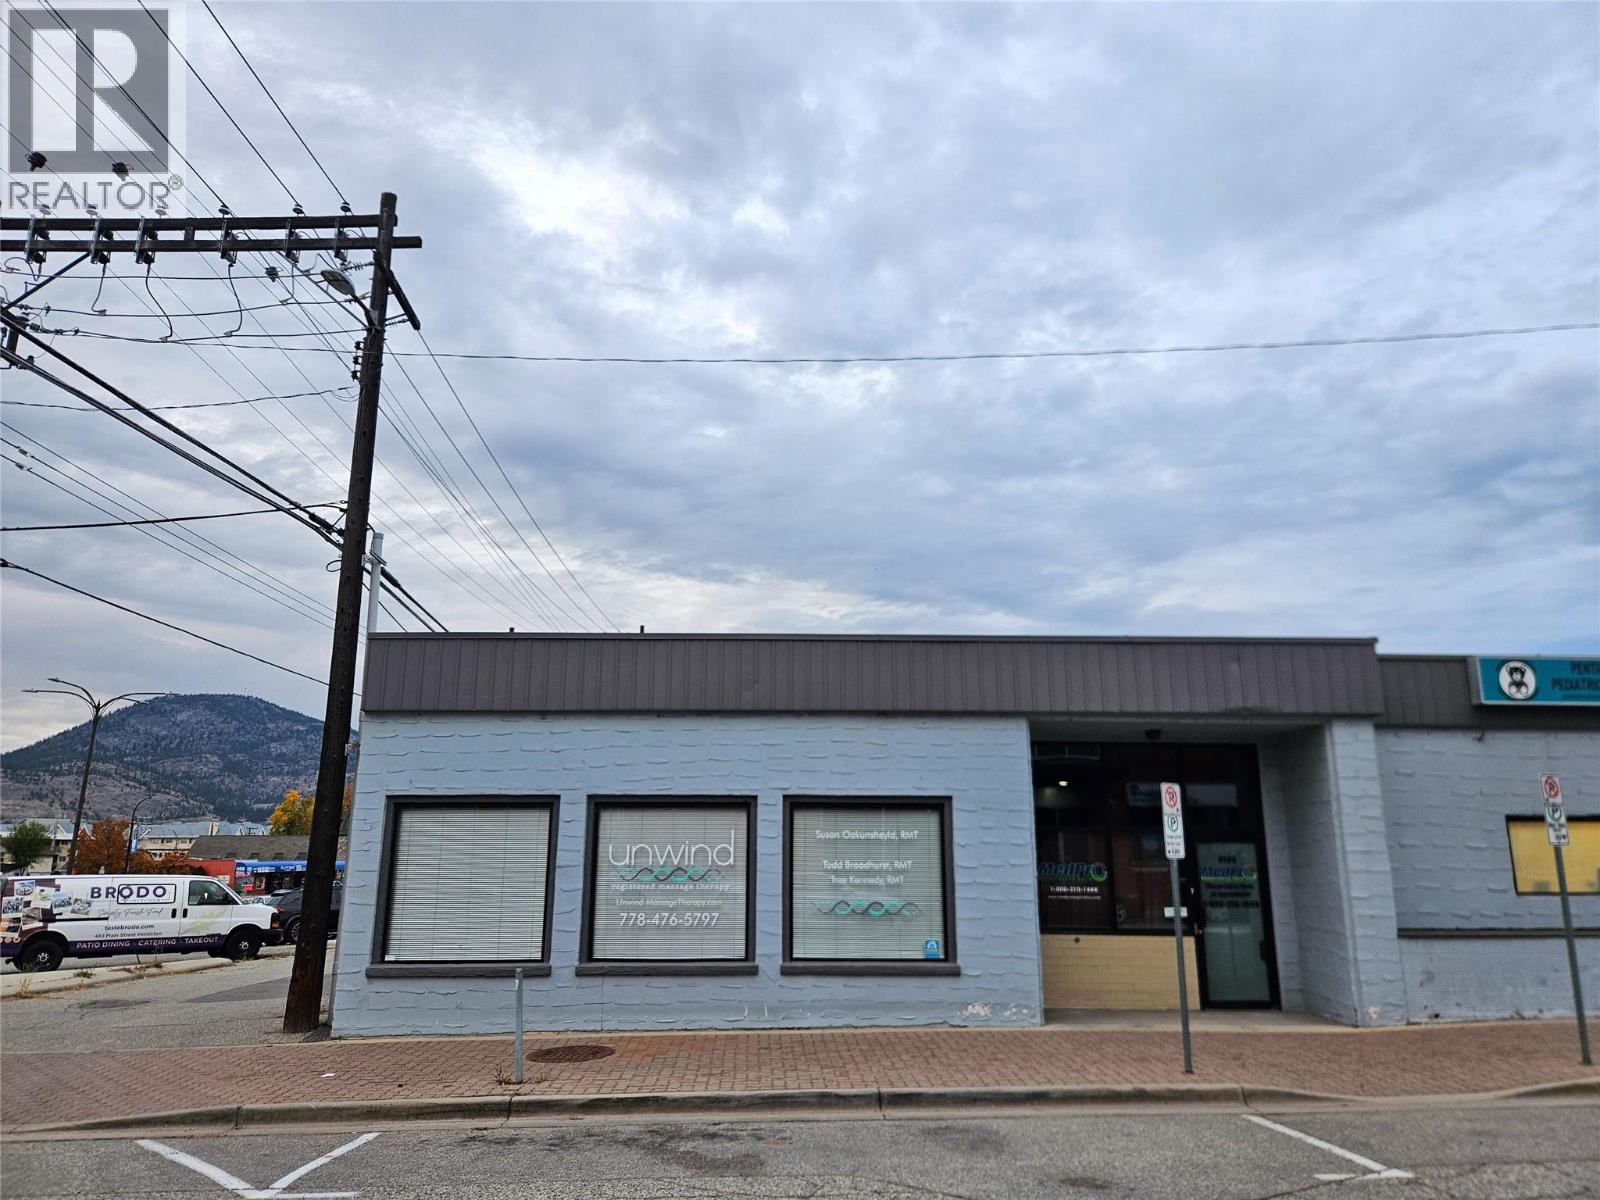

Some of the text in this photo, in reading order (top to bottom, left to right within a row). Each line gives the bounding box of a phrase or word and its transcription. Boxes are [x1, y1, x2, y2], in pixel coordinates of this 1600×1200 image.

[815, 830, 840, 839] Susan
[900, 830, 919, 839] RMT
[608, 829, 735, 866] unwind
[822, 860, 843, 869] Todd
[894, 860, 913, 869] RMT
[886, 875, 905, 884] RMT
[90, 885, 167, 899] BRODO
[611, 883, 730, 892] registered massage therapy
[618, 912, 720, 927] 778-476-5797
[104, 923, 155, 931] tastebrodo.com
[76, 936, 219, 949] PATIO DINING CATERING TAKEOUT
